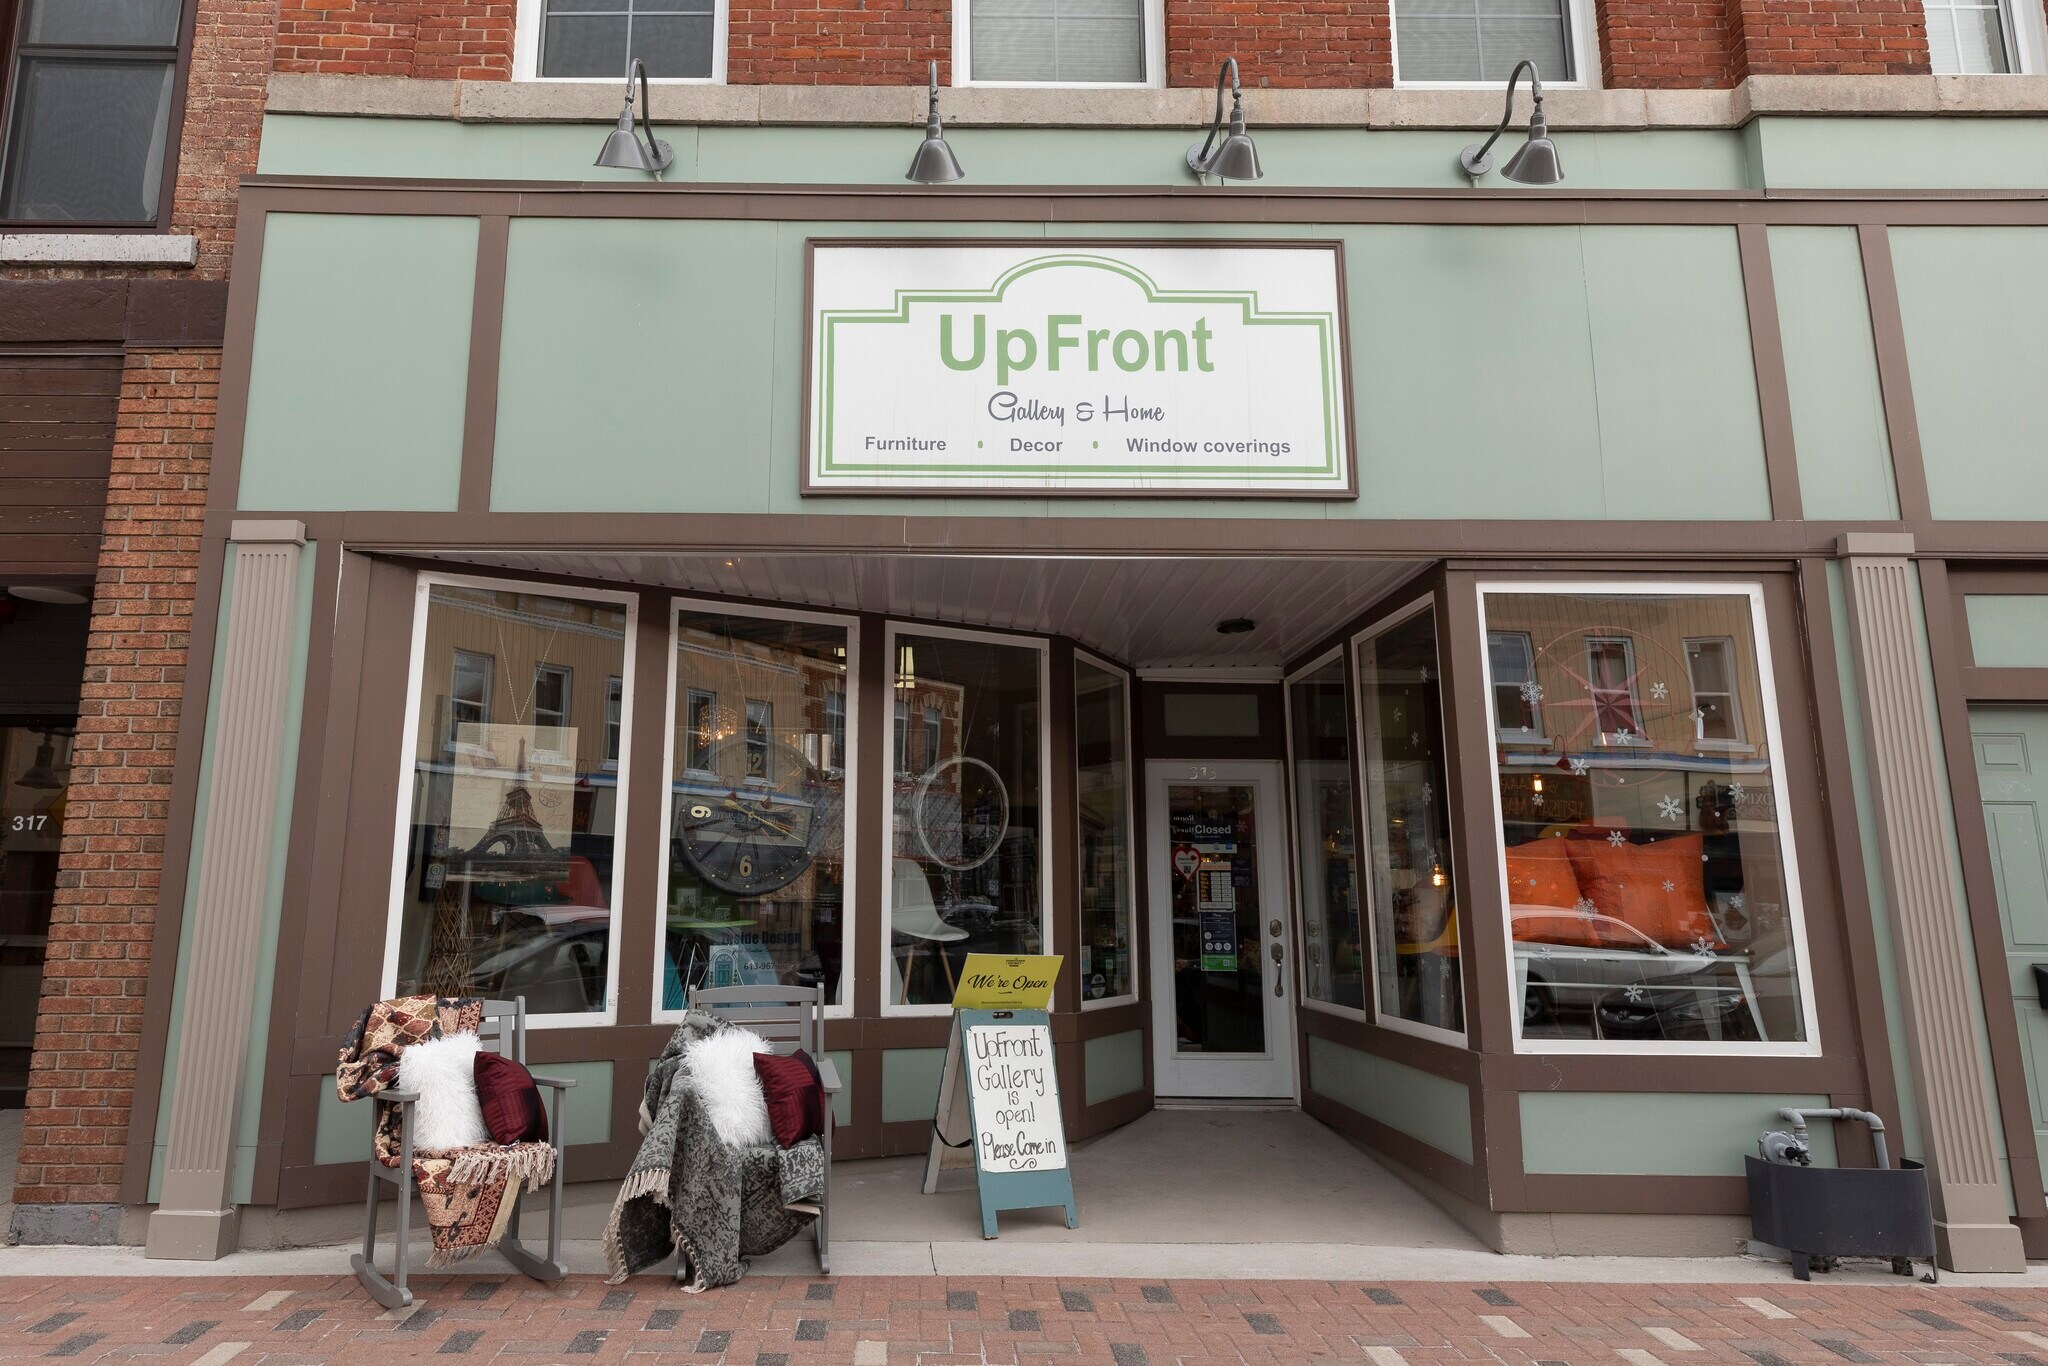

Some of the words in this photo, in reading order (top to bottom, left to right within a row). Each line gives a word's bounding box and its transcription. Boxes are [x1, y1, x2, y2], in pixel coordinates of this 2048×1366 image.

[940, 314, 1214, 385] UpFront
[988, 391, 1065, 427] Gallery
[1076, 402, 1095, 422] &
[1103, 395, 1165, 422] Home
[865, 436, 947, 451] Furniture
[1010, 437, 1063, 452] Decor
[1126, 437, 1198, 453] Window
[1204, 438, 1291, 456] coverings
[1189, 765, 1217, 780] 313
[11, 815, 48, 831] 317
[1195, 824, 1231, 834] Closed
[739, 854, 752, 877] 6
[762, 931, 801, 945] Design
[967, 974, 1010, 989] We're
[1012, 975, 1048, 991] Open
[974, 1028, 1043, 1068] UpFront
[977, 1064, 1045, 1097] Gallery
[1008, 1090, 1020, 1106] is
[996, 1101, 1036, 1130] open!
[981, 1131, 1016, 1160] Please
[1016, 1130, 1045, 1156] Come
[1045, 1138, 1057, 1154] in
